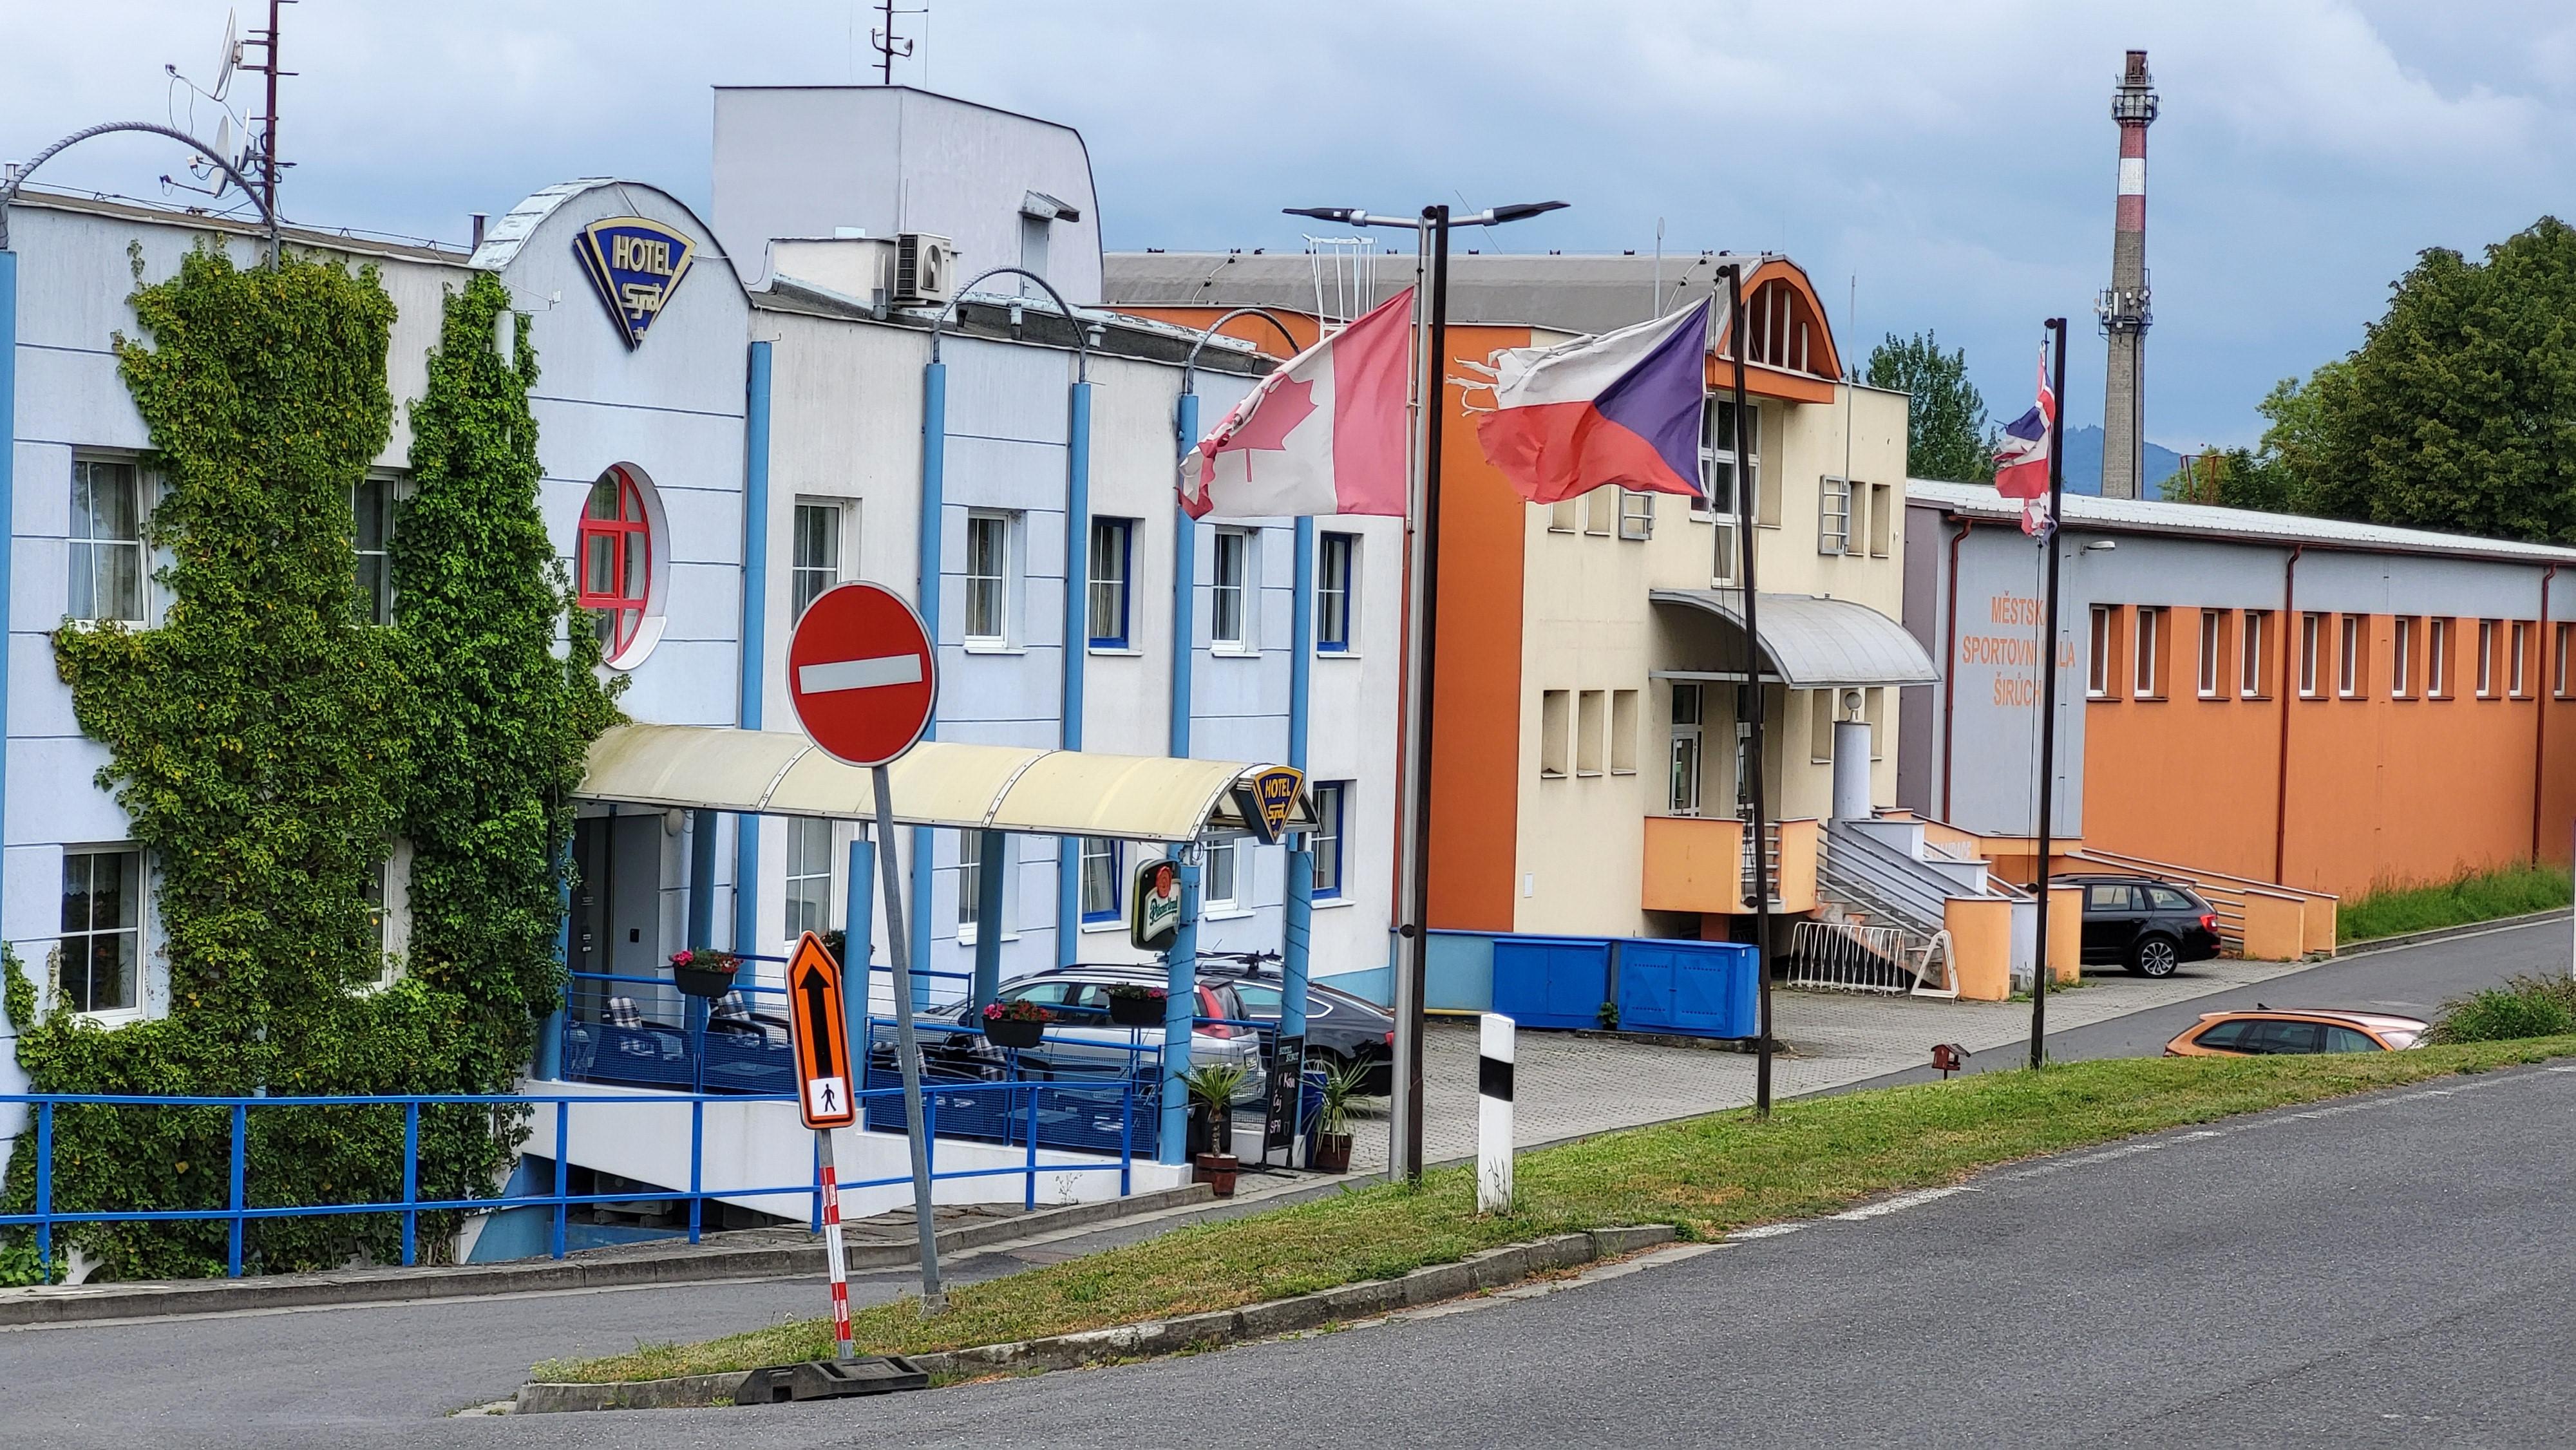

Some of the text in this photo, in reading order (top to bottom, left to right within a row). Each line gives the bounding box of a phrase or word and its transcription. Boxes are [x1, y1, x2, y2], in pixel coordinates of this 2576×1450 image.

[612, 234, 674, 276] HOTEL
[1991, 590, 2048, 626] MĚSTSK
[1962, 636, 2076, 668] SPORTOVN HLA
[1265, 777, 1291, 798] HOTEL
